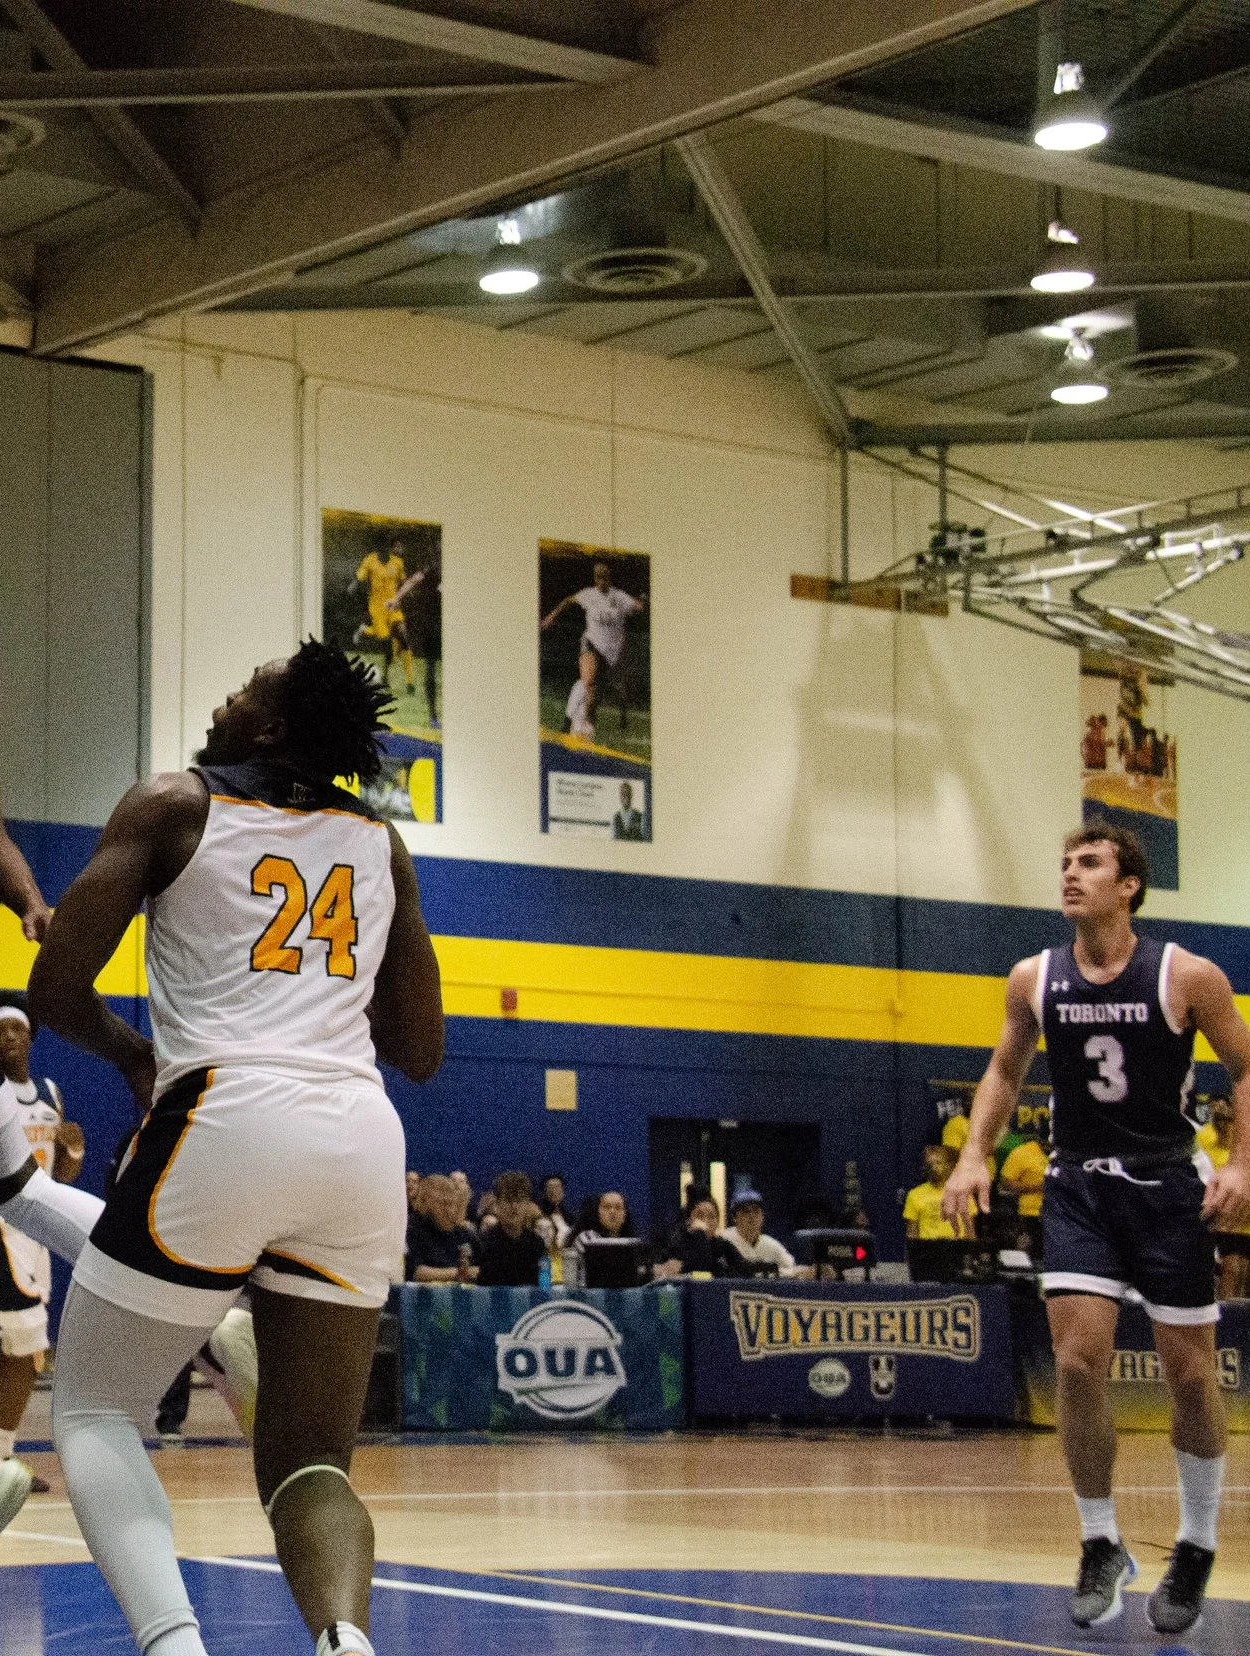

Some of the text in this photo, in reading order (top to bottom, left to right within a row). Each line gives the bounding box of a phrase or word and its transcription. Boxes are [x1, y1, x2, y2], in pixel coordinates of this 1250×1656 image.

[251, 853, 359, 980] 24
[1056, 1002, 1149, 1023] TORONTO
[1084, 1034, 1129, 1103] 3
[737, 1299, 975, 1352] VOYAGEURS
[504, 1345, 618, 1378] OUA
